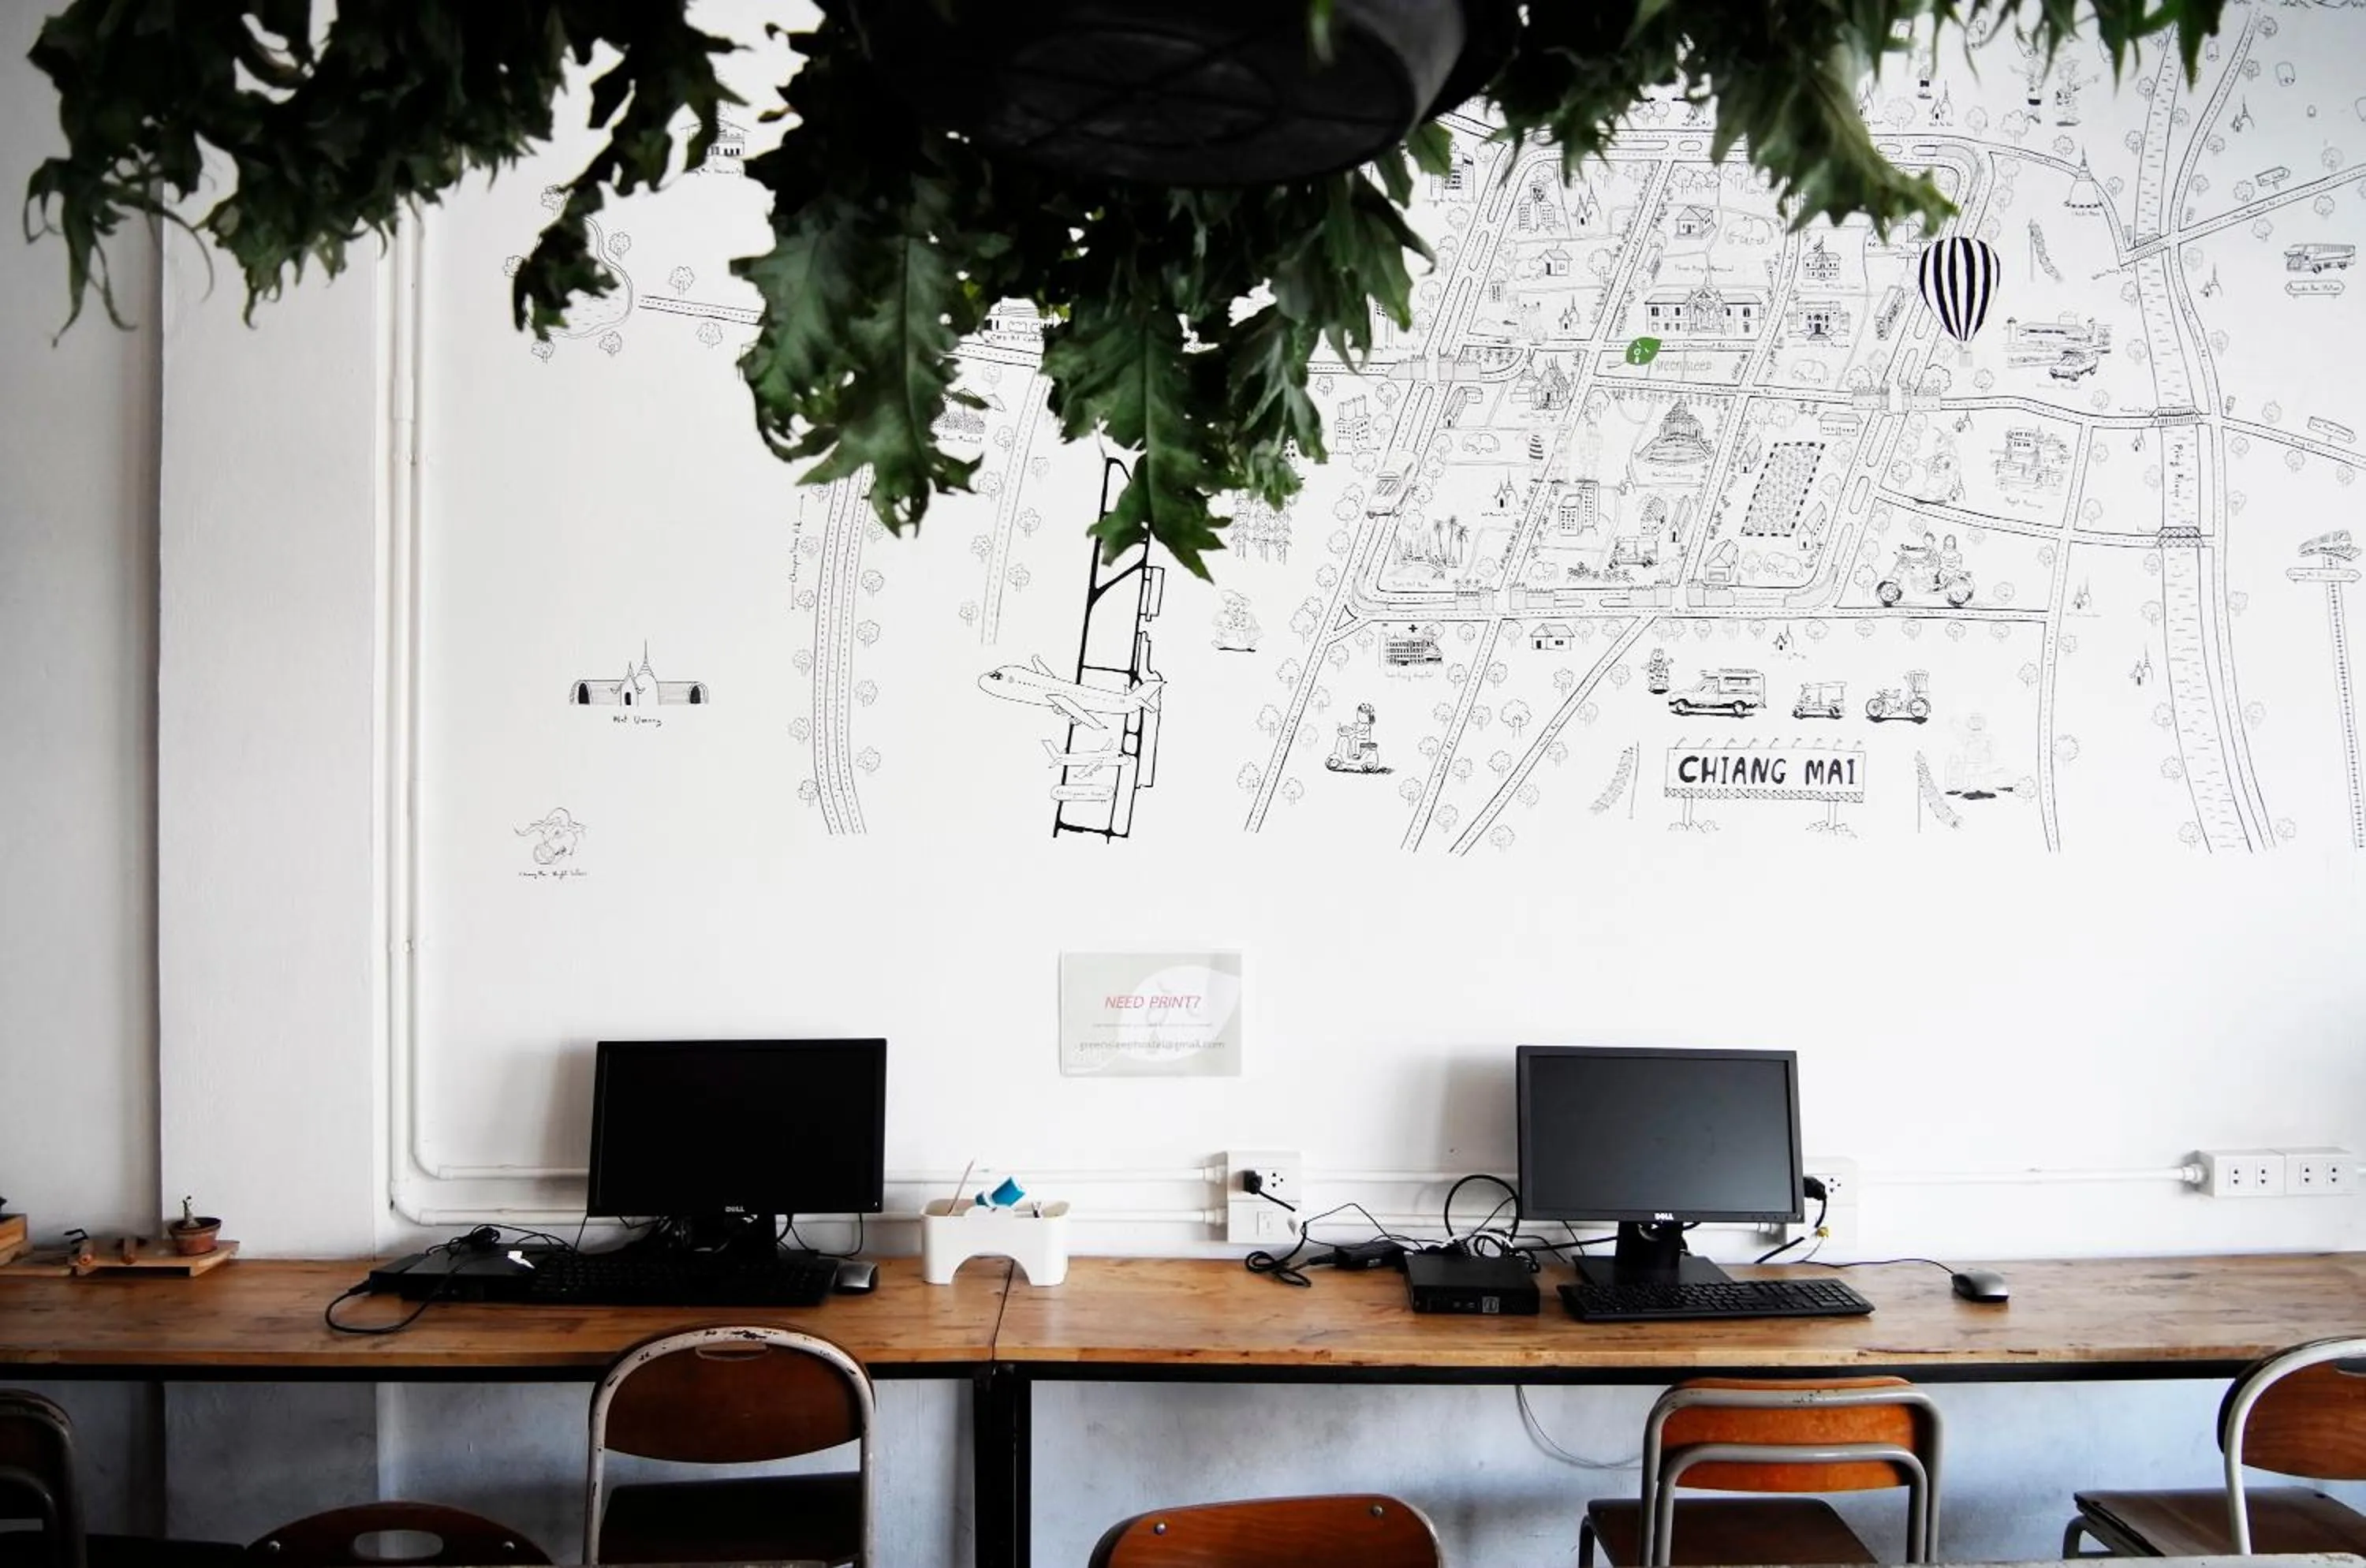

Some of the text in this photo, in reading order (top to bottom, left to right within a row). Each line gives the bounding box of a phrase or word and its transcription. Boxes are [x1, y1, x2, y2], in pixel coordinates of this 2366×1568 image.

[1678, 756, 1856, 785] CHIANG MAI
[1104, 995, 1201, 1009] NEED PRINT?
